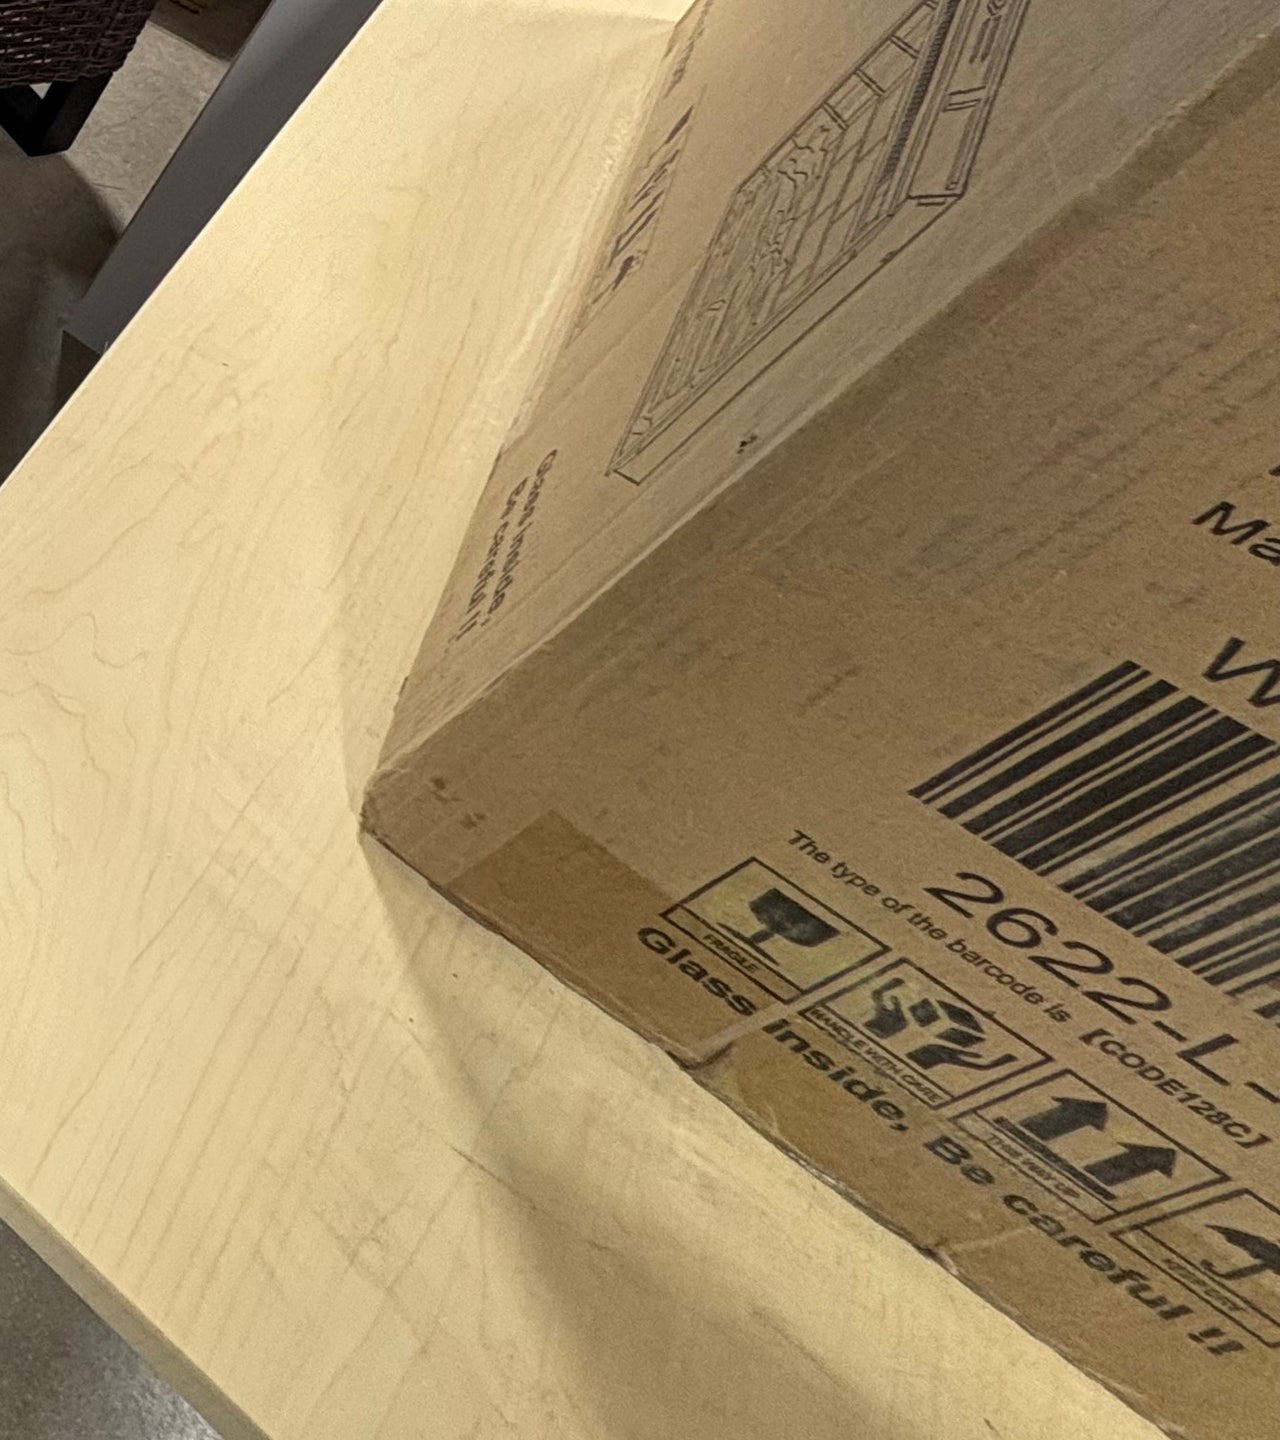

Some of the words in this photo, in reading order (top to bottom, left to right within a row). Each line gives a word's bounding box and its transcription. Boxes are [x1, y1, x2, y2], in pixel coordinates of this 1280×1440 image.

[789, 829, 831, 866] The
[830, 860, 882, 898] type
[881, 894, 917, 915] of
[907, 913, 948, 942] the
[946, 937, 1045, 1006] barcode
[1044, 1002, 1073, 1023] is
[638, 926, 758, 1017] Glass
[923, 1135, 996, 1187] Be
[1002, 1194, 1195, 1321] careful
[901, 1073, 943, 1105] CARE
